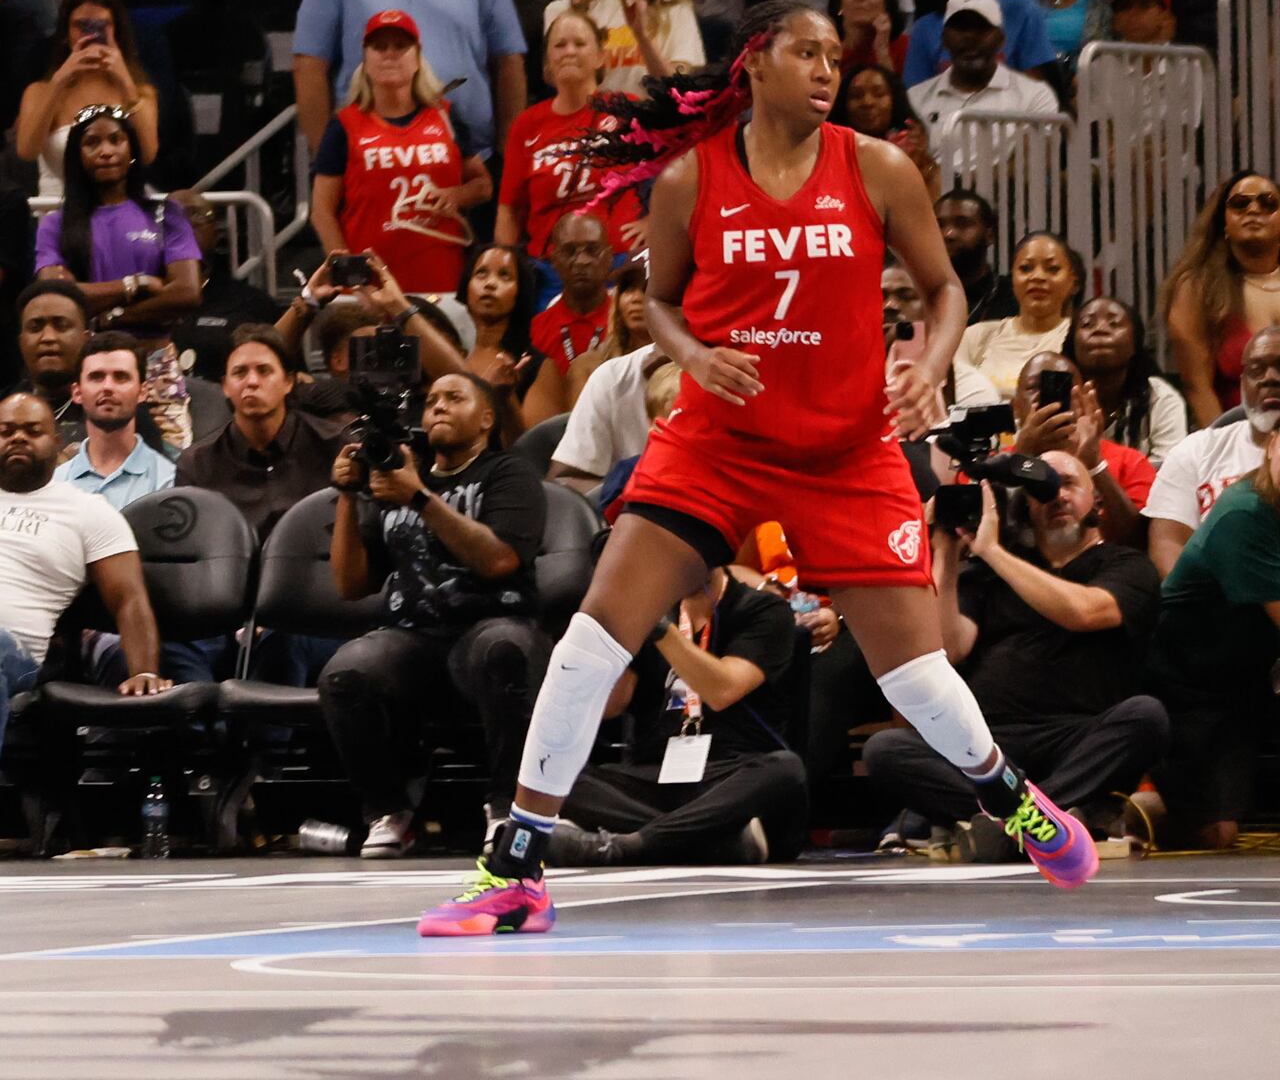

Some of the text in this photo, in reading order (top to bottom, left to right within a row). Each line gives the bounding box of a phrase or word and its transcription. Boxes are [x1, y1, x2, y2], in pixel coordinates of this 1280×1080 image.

[364, 143, 450, 171] FEVER
[722, 223, 855, 264] FEVER
[773, 270, 801, 320] 7
[730, 326, 822, 349] salesforce
